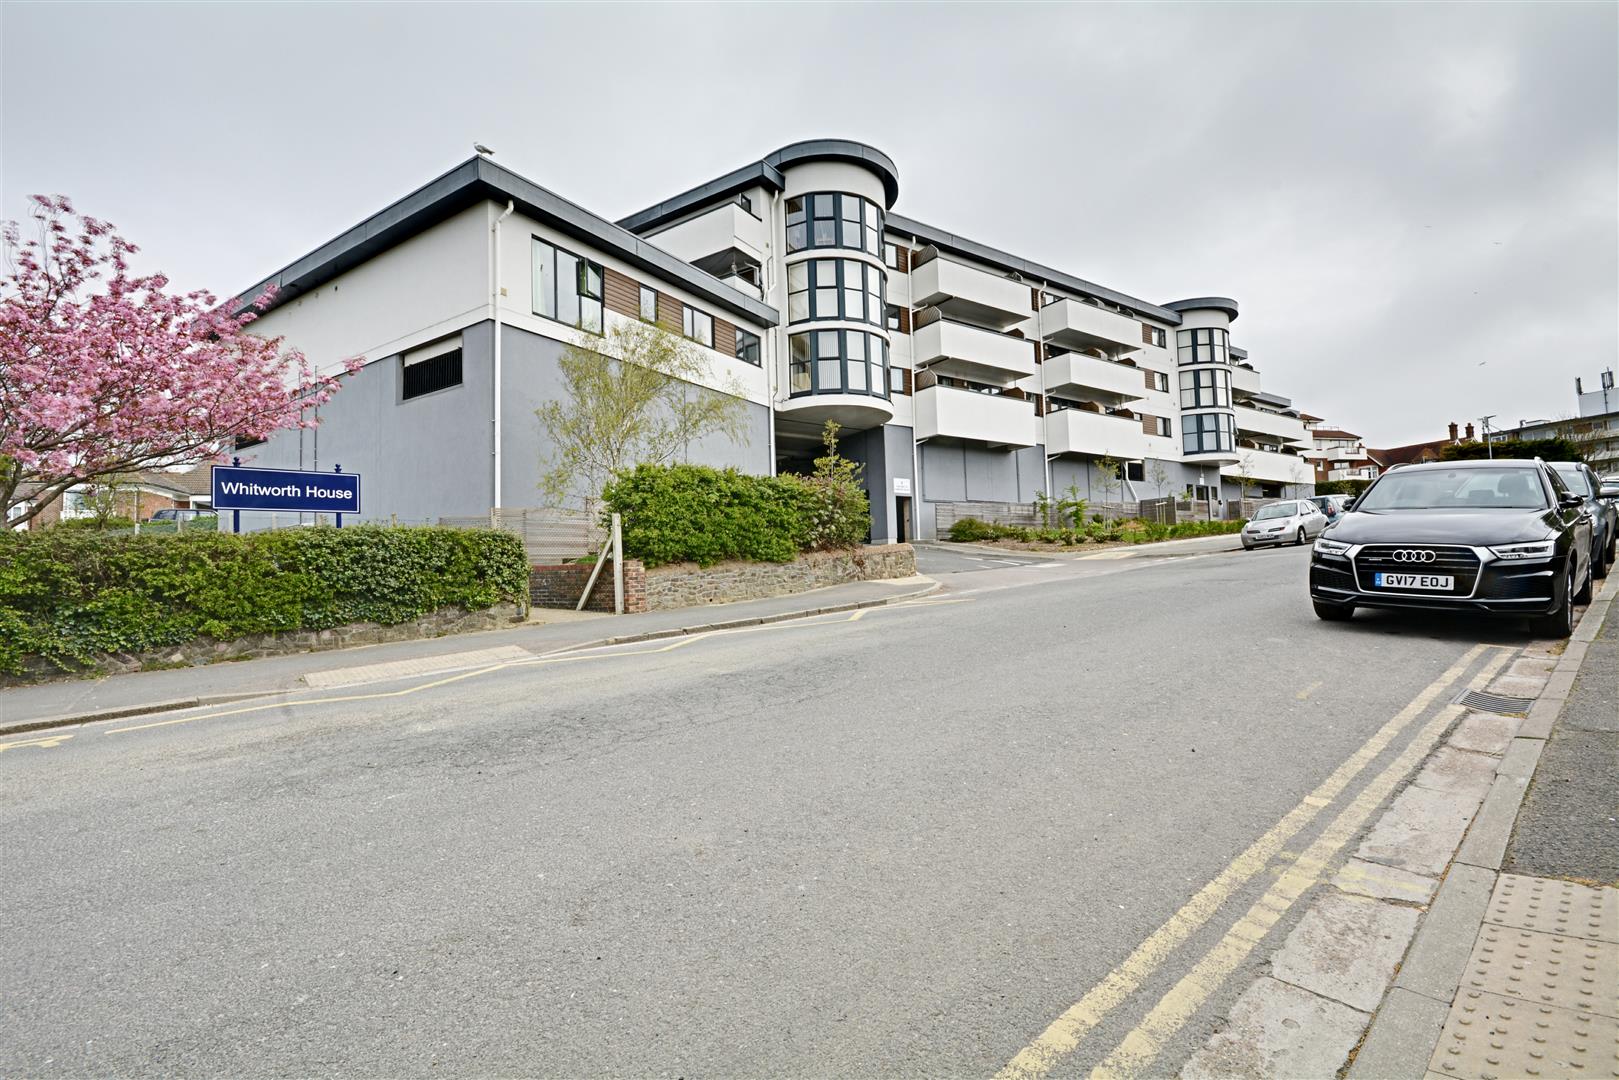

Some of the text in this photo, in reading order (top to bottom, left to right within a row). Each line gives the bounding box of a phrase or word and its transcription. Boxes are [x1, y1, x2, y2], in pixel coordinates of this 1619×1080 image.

[221, 481, 353, 499] Whitworth House
[1386, 575, 1449, 588] GV17 EOJ
